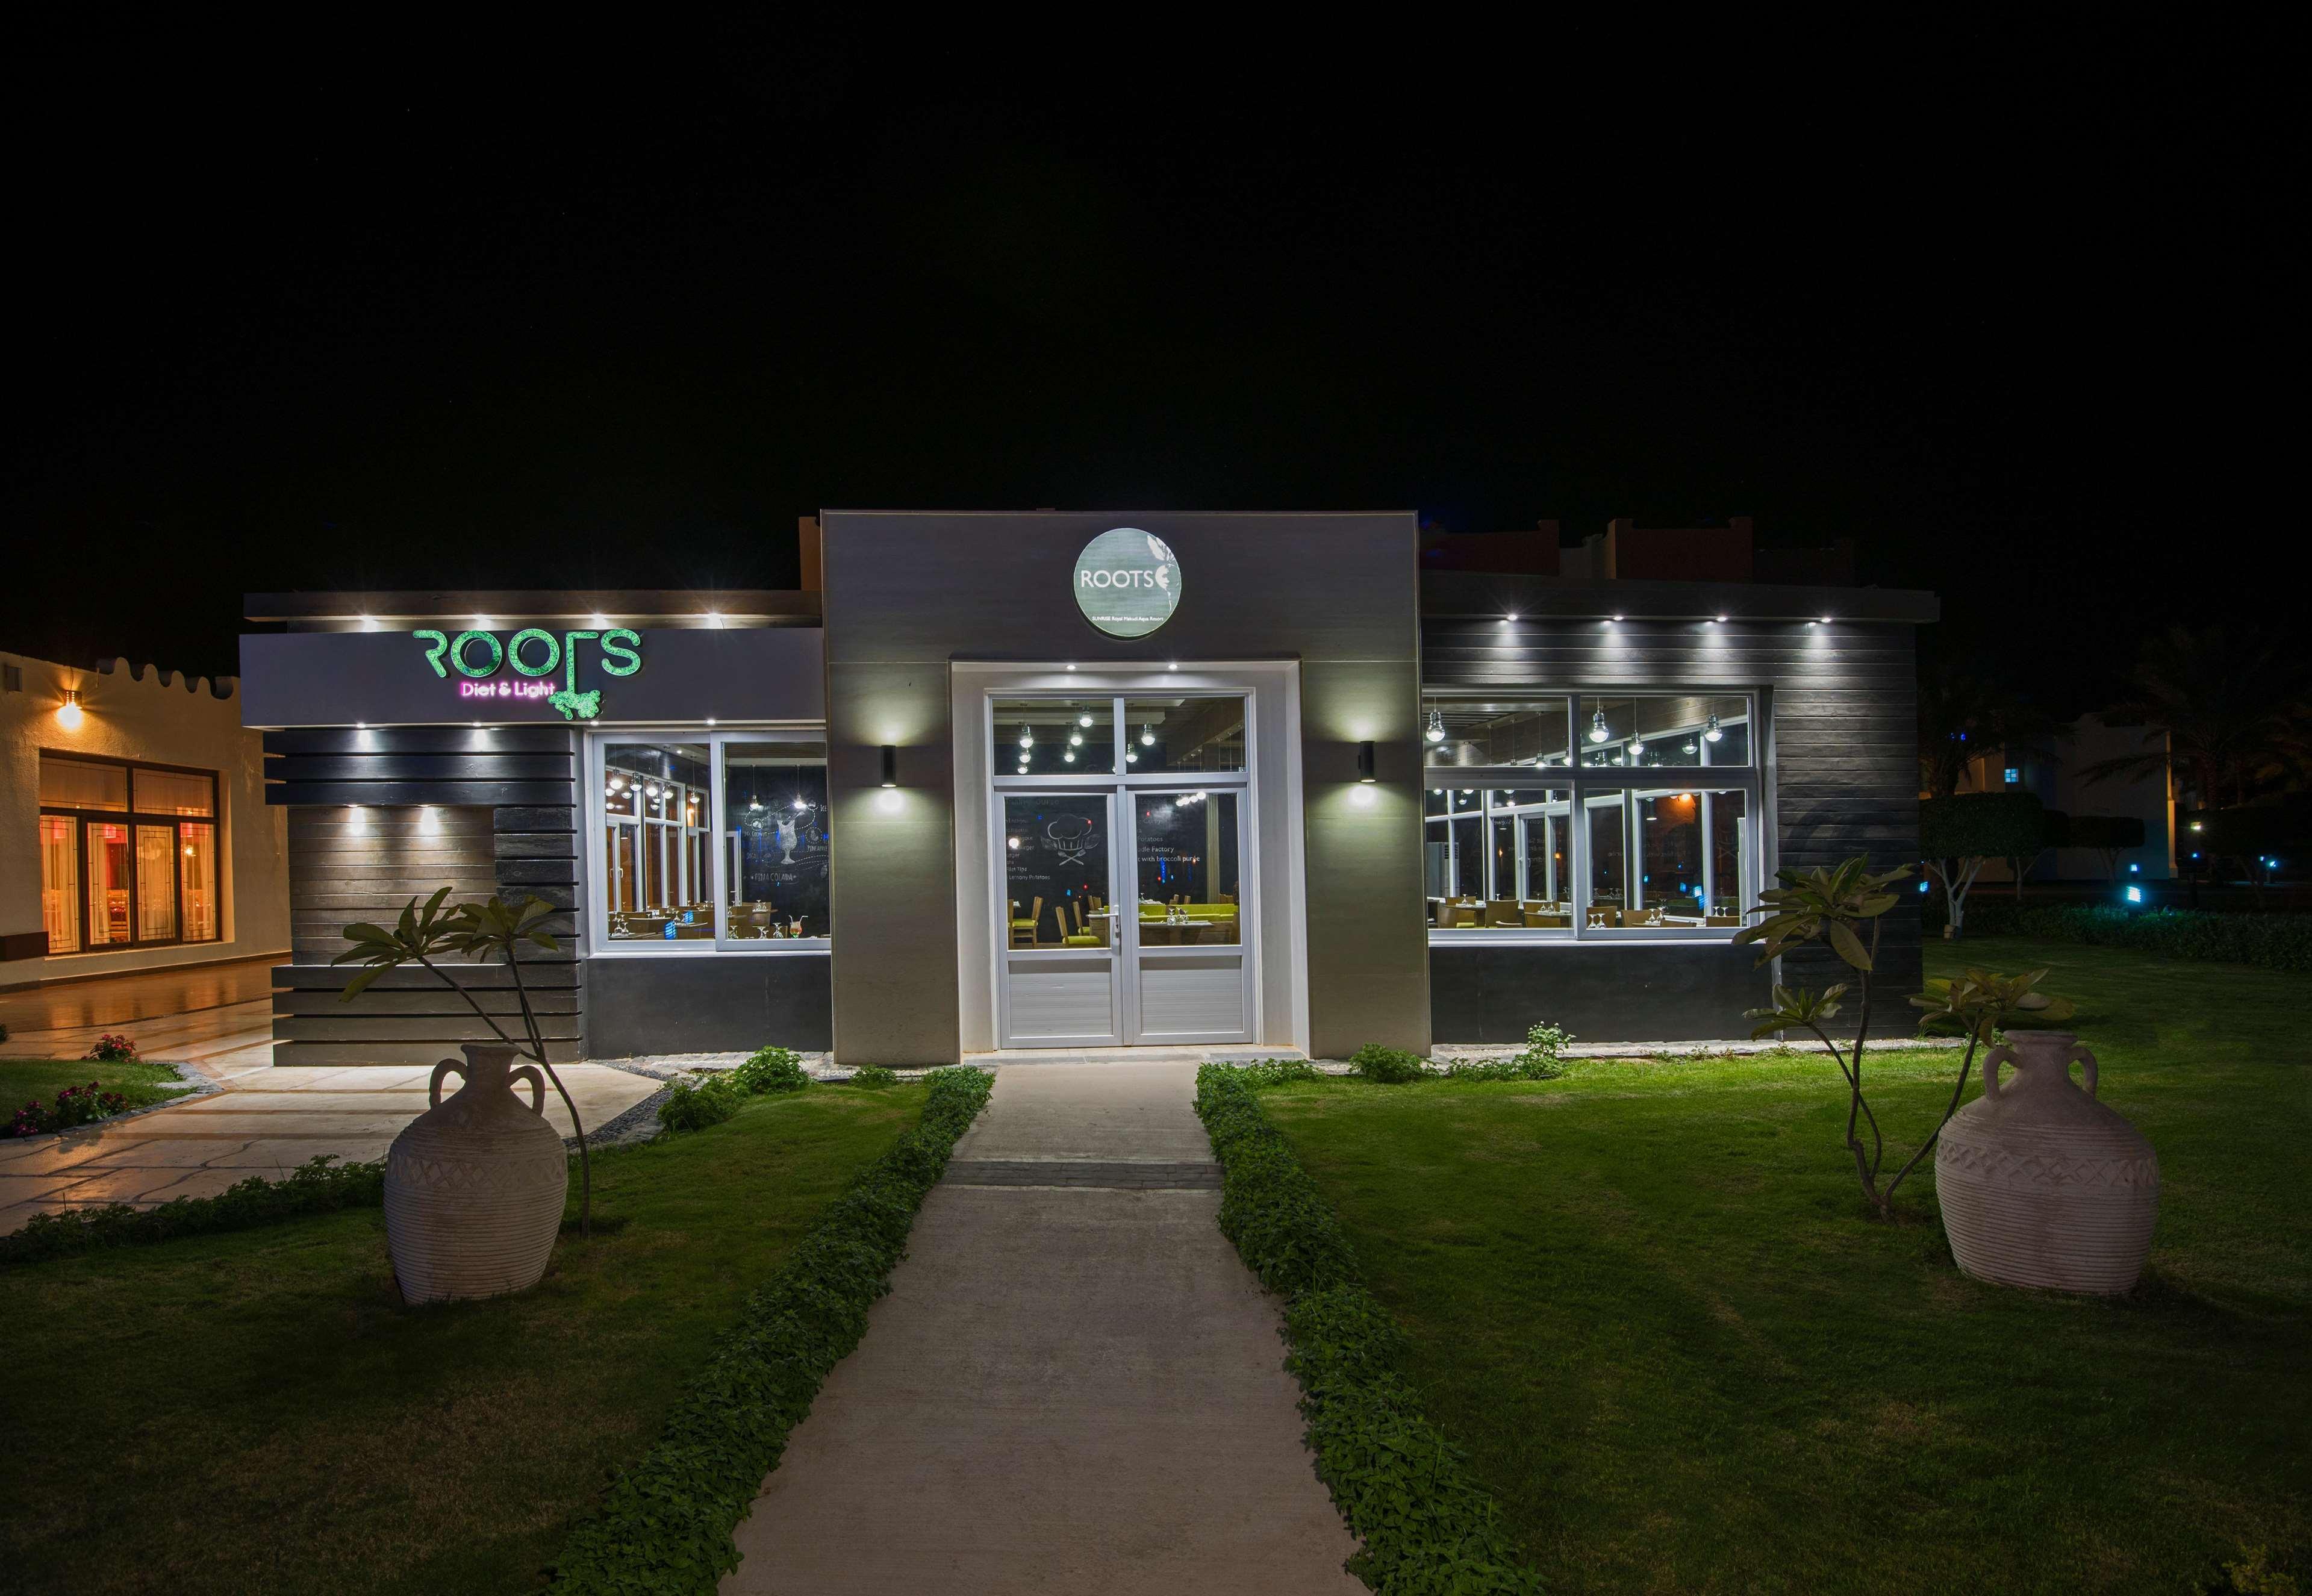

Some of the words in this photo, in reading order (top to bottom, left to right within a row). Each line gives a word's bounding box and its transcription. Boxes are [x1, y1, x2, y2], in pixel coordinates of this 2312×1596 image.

[1080, 570, 1154, 588] ROOTS
[413, 628, 641, 699] ROOTS
[461, 682, 496, 696] Diet
[499, 682, 511, 696] &
[514, 681, 555, 699] Light
